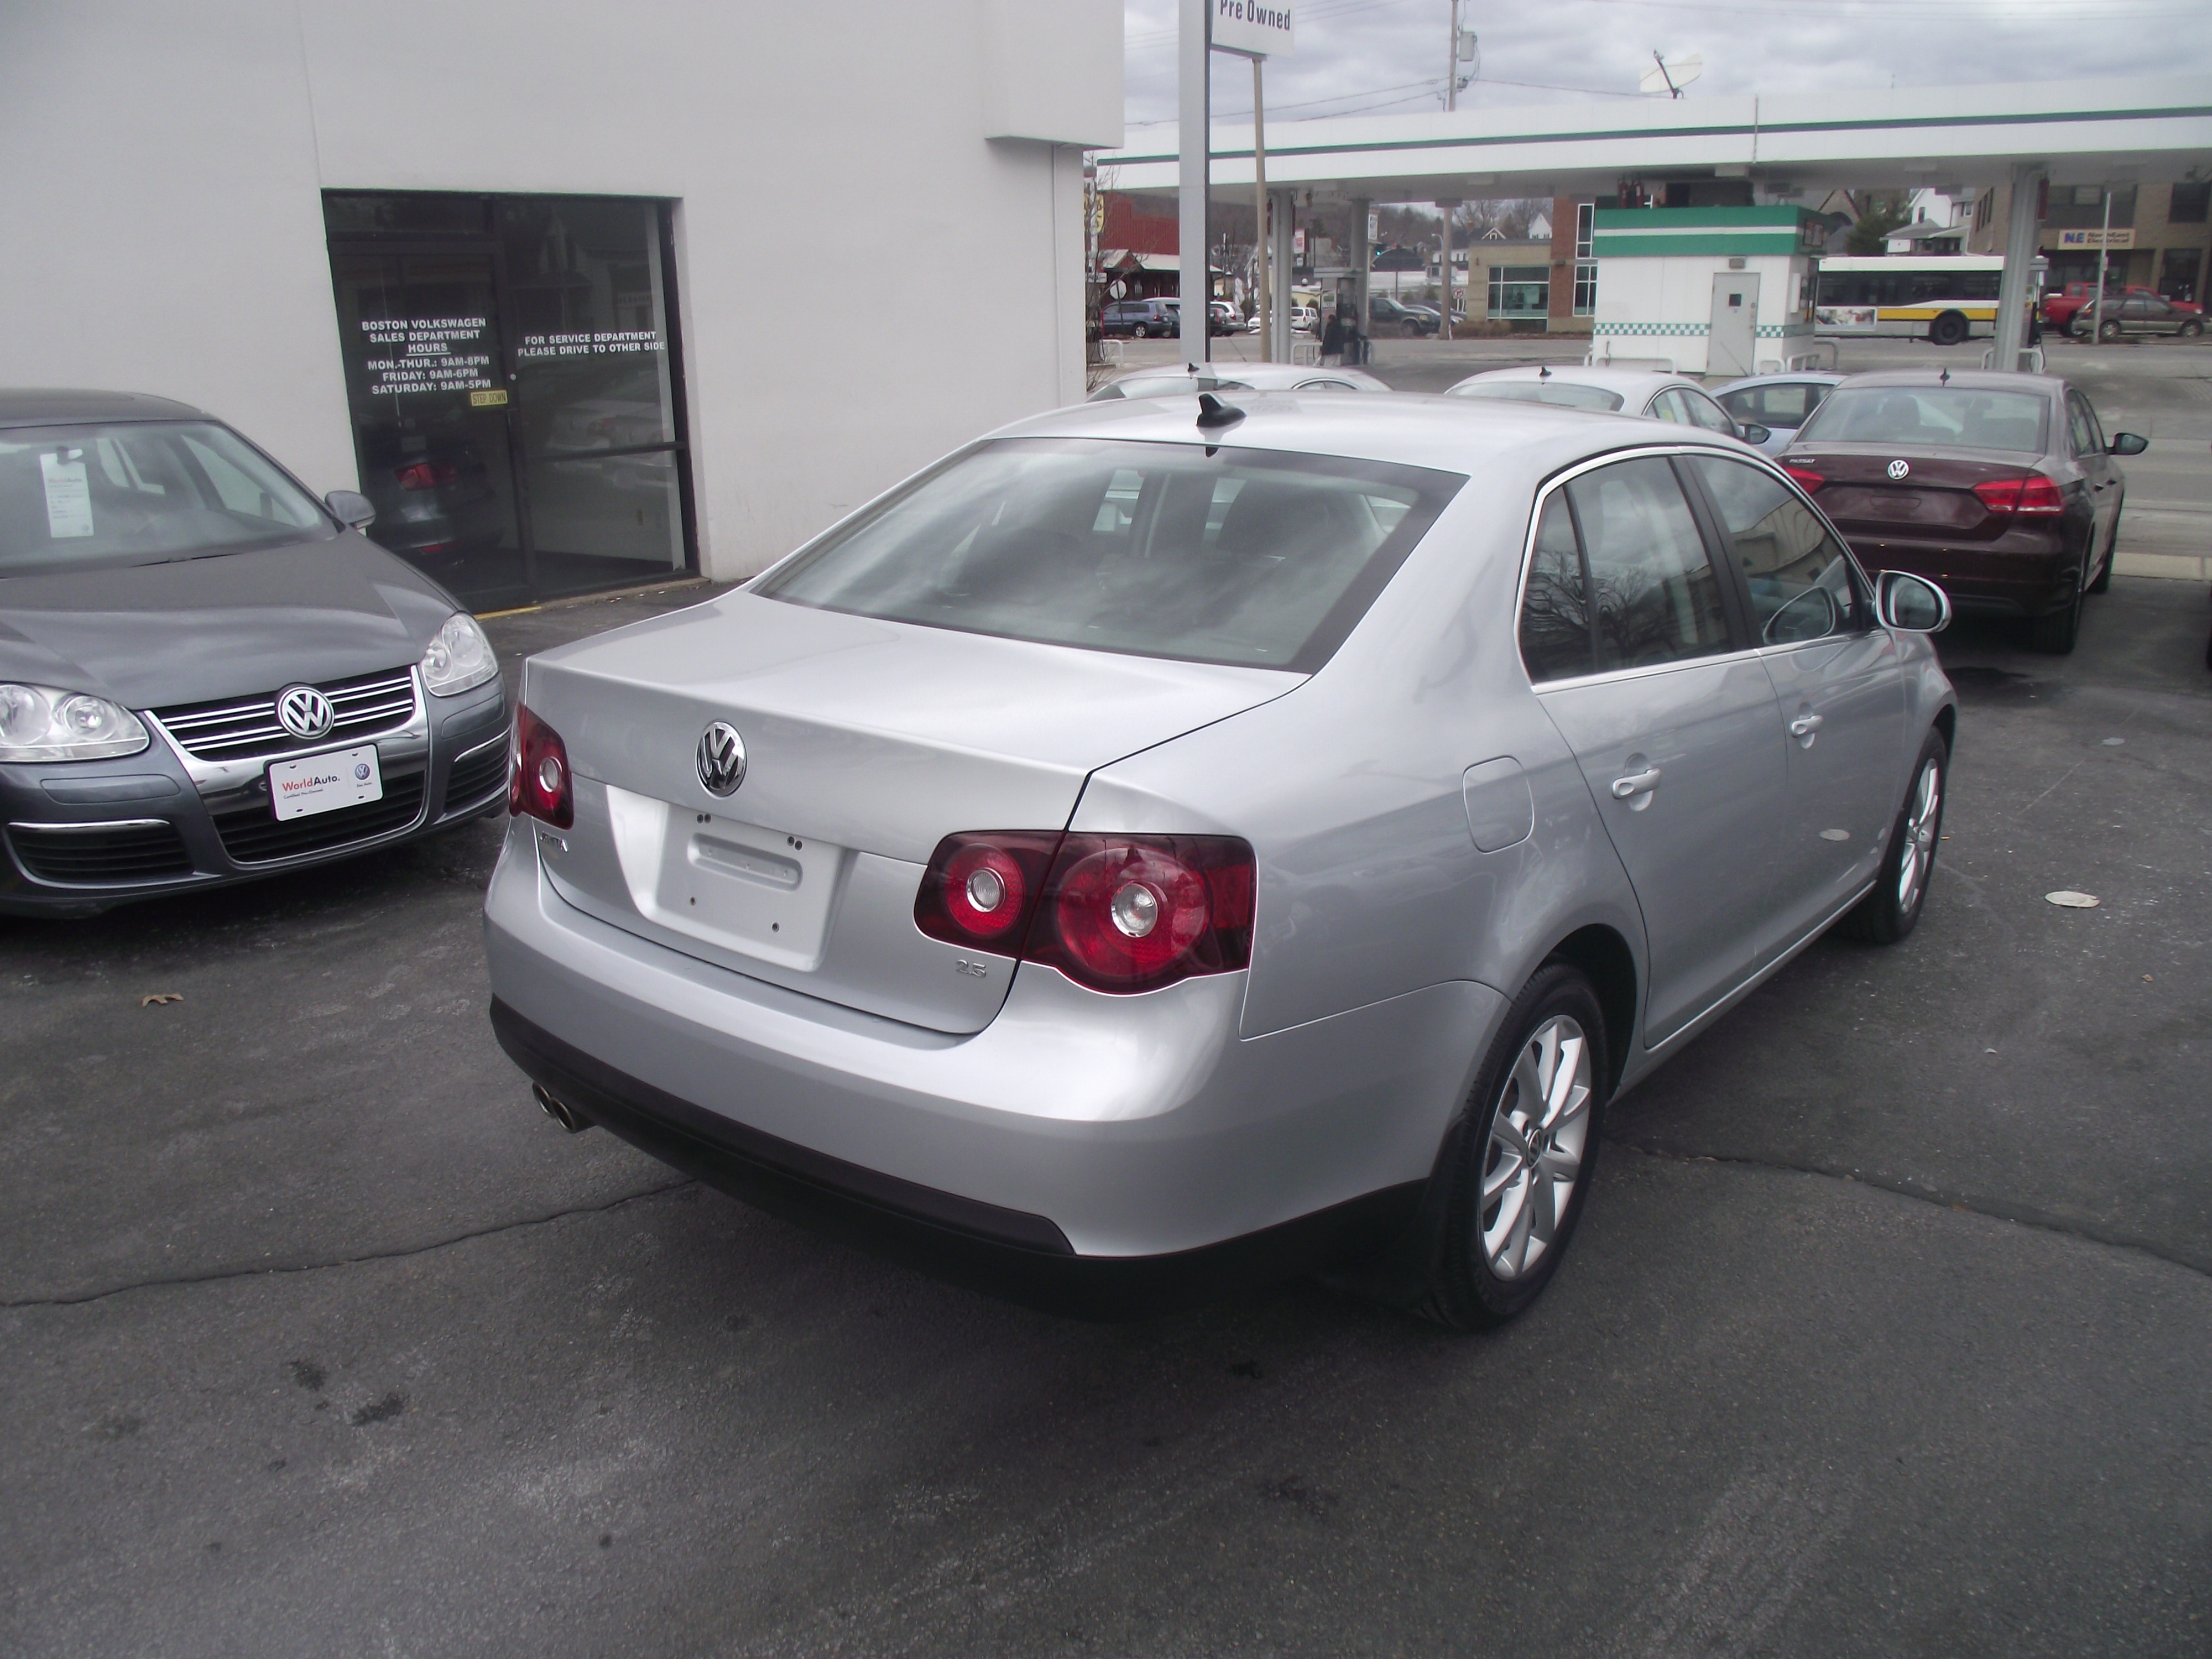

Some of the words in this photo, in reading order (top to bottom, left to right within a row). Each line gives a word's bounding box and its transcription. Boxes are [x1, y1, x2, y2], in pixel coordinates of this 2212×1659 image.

[1220, 0, 1242, 20] Pre
[1247, 0, 1290, 30] Owned
[362, 320, 408, 331] BOSTON
[411, 318, 486, 329] VOLKSWAGEN
[370, 332, 405, 343] SALES
[409, 330, 481, 341] DEPARTMENT
[525, 335, 545, 345] FOR
[549, 333, 591, 343] SERVICE
[594, 331, 656, 342] DEPARTMENT
[408, 342, 448, 353] HOURS
[518, 346, 556, 357] PLEASE
[559, 345, 589, 354] DRIVE
[593, 344, 606, 353] TO
[609, 343, 640, 353] OTHER
[644, 341, 665, 351] SIDE
[368, 359, 437, 371] MON.-THUR.:
[441, 356, 489, 367] 9AM-8PM
[383, 371, 426, 382] FRIDAY:
[430, 368, 478, 380] 9AM-6PM
[372, 382, 436, 394] SATURDAY:
[441, 379, 491, 390] 9AM-5PM
[472, 393, 487, 404] STEP
[489, 392, 506, 403] DOWN
[282, 775, 340, 791] WorldAuto.
[956, 959, 986, 977] 2.5
